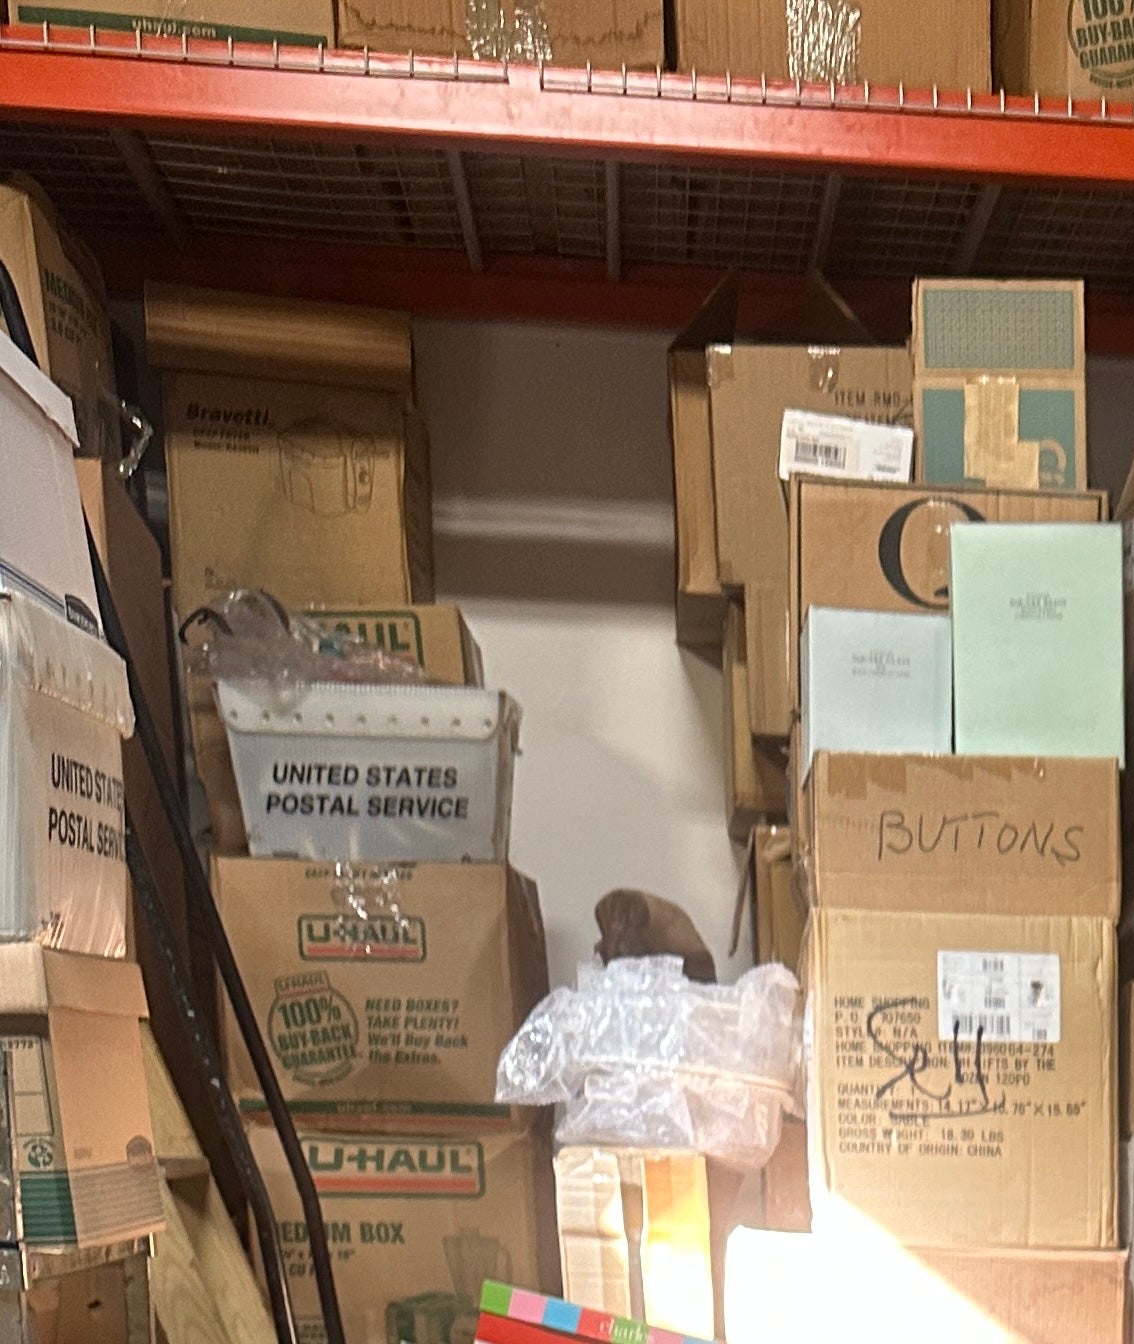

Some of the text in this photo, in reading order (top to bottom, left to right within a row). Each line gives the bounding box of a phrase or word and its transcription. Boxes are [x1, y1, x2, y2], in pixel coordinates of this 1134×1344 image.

[51, 752, 93, 799] UNITED
[272, 761, 459, 790] UNITED STATES
[266, 793, 470, 819] POSTAL SERVICE
[48, 806, 95, 853] POSTAL
[878, 809, 1084, 867] BUTTONS
[278, 996, 342, 1030] 100%
[365, 997, 460, 1013] NEED BOXES?
[834, 995, 864, 1008] HOME
[367, 1015, 460, 1031] TAKE PLENTY!
[277, 1023, 351, 1052] BUY-BACK
[367, 1033, 468, 1049] We'll Buy Back
[836, 1040, 864, 1053] HOME
[368, 1050, 391, 1065] the
[308, 1144, 472, 1174] U-HAUL
[839, 1142, 892, 1156] COUNTRY
[966, 1144, 1002, 1157] CHINA
[360, 1221, 405, 1245] BOX
